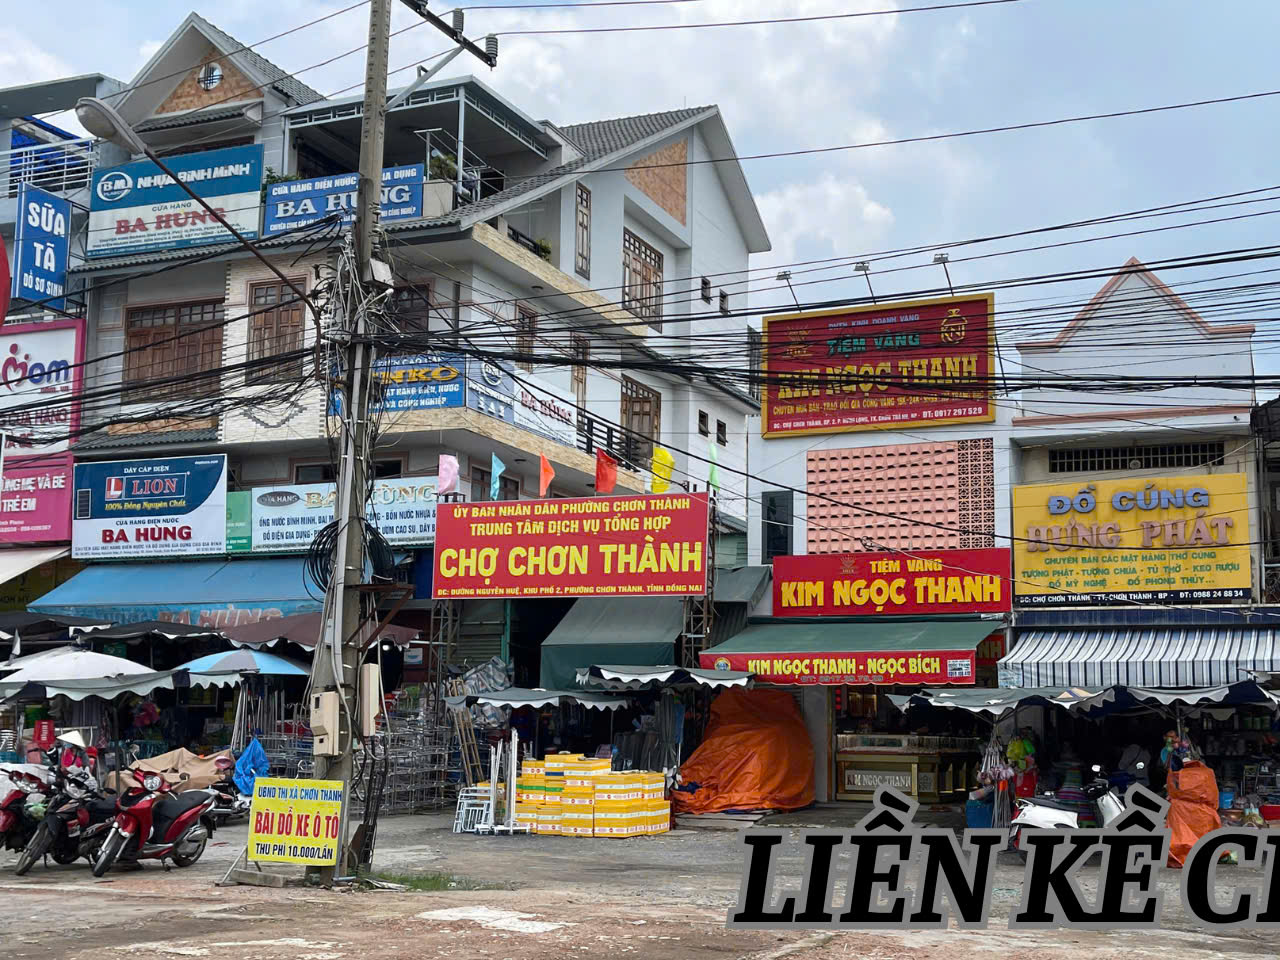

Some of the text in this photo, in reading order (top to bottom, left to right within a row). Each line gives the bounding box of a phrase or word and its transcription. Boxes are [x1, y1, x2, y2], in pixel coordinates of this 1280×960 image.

[275, 199, 317, 218] BA
[28, 202, 65, 237] SỮA
[115, 217, 148, 235] BA
[33, 242, 55, 272] TÃ
[899, 354, 978, 384] THANH
[131, 478, 178, 495] LION
[105, 503, 122, 511] 100%
[453, 498, 690, 518] ỦY BAN NHÂN DÂN PHƯỜNG CHƠN THÀNH
[1047, 484, 1209, 515] ĐỒ CÚNG
[102, 524, 192, 544] BA HÙNG
[470, 513, 671, 536] TRUNG TÂM DỊCH VỤ TỔNG HỢP
[1026, 511, 1233, 553] HƯNG PHÁT
[439, 535, 702, 585] CHỢ CHƠN THÀNH
[870, 559, 900, 574] TIỆM
[1145, 577, 1176, 585] PHONG
[781, 575, 1001, 612] KIM NGỌC THANH
[748, 659, 770, 675] KIM
[773, 659, 809, 679] NGỌC
[813, 658, 856, 674] THANH
[867, 658, 906, 678] NGỌC
[909, 654, 940, 674] BÍCH
[258, 786, 276, 798] UBND
[254, 807, 339, 839] BÃI ĐỖ XE Ô TÔ
[256, 843, 269, 855] THU
[272, 844, 285, 856] PHÍ
